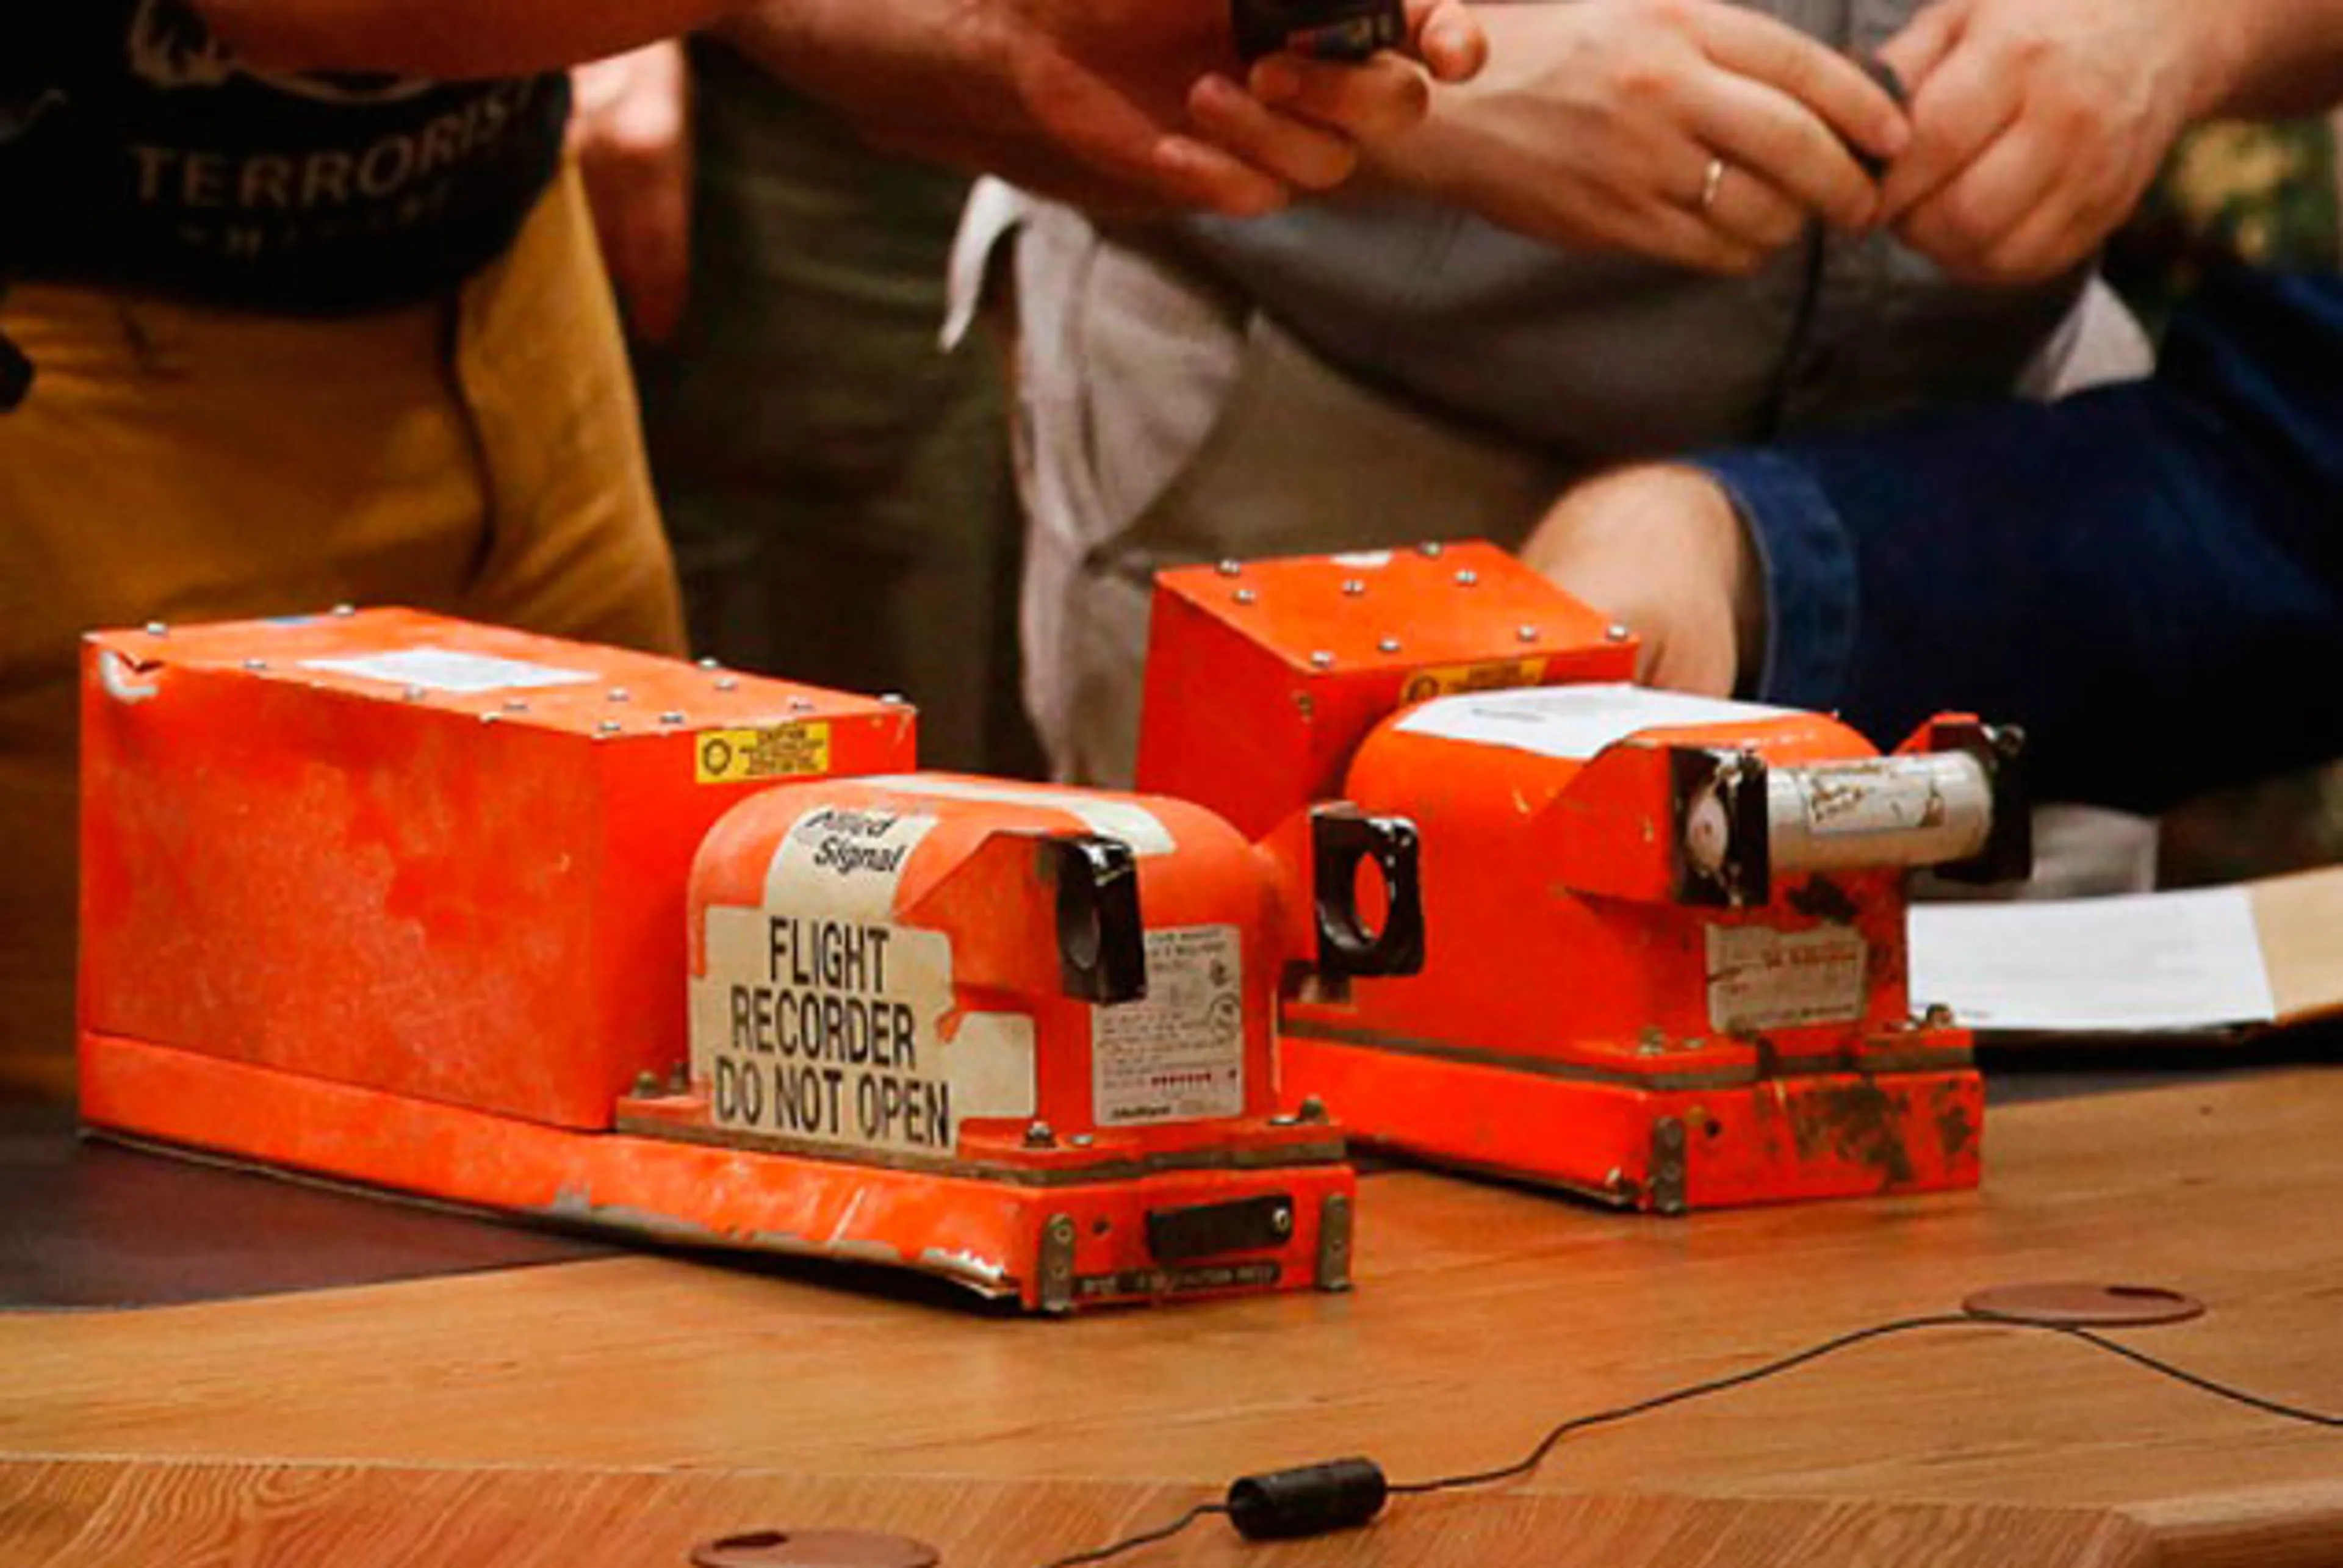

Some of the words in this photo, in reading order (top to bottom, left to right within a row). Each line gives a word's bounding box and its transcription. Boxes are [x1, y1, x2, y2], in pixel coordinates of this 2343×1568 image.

[814, 836, 907, 875] Signal
[769, 916, 889, 993] FLIGHT
[732, 985, 916, 1070] RECORDER
[714, 1056, 762, 1124] DO
[774, 1065, 844, 1134] NOT
[857, 1073, 950, 1148] OPEN
